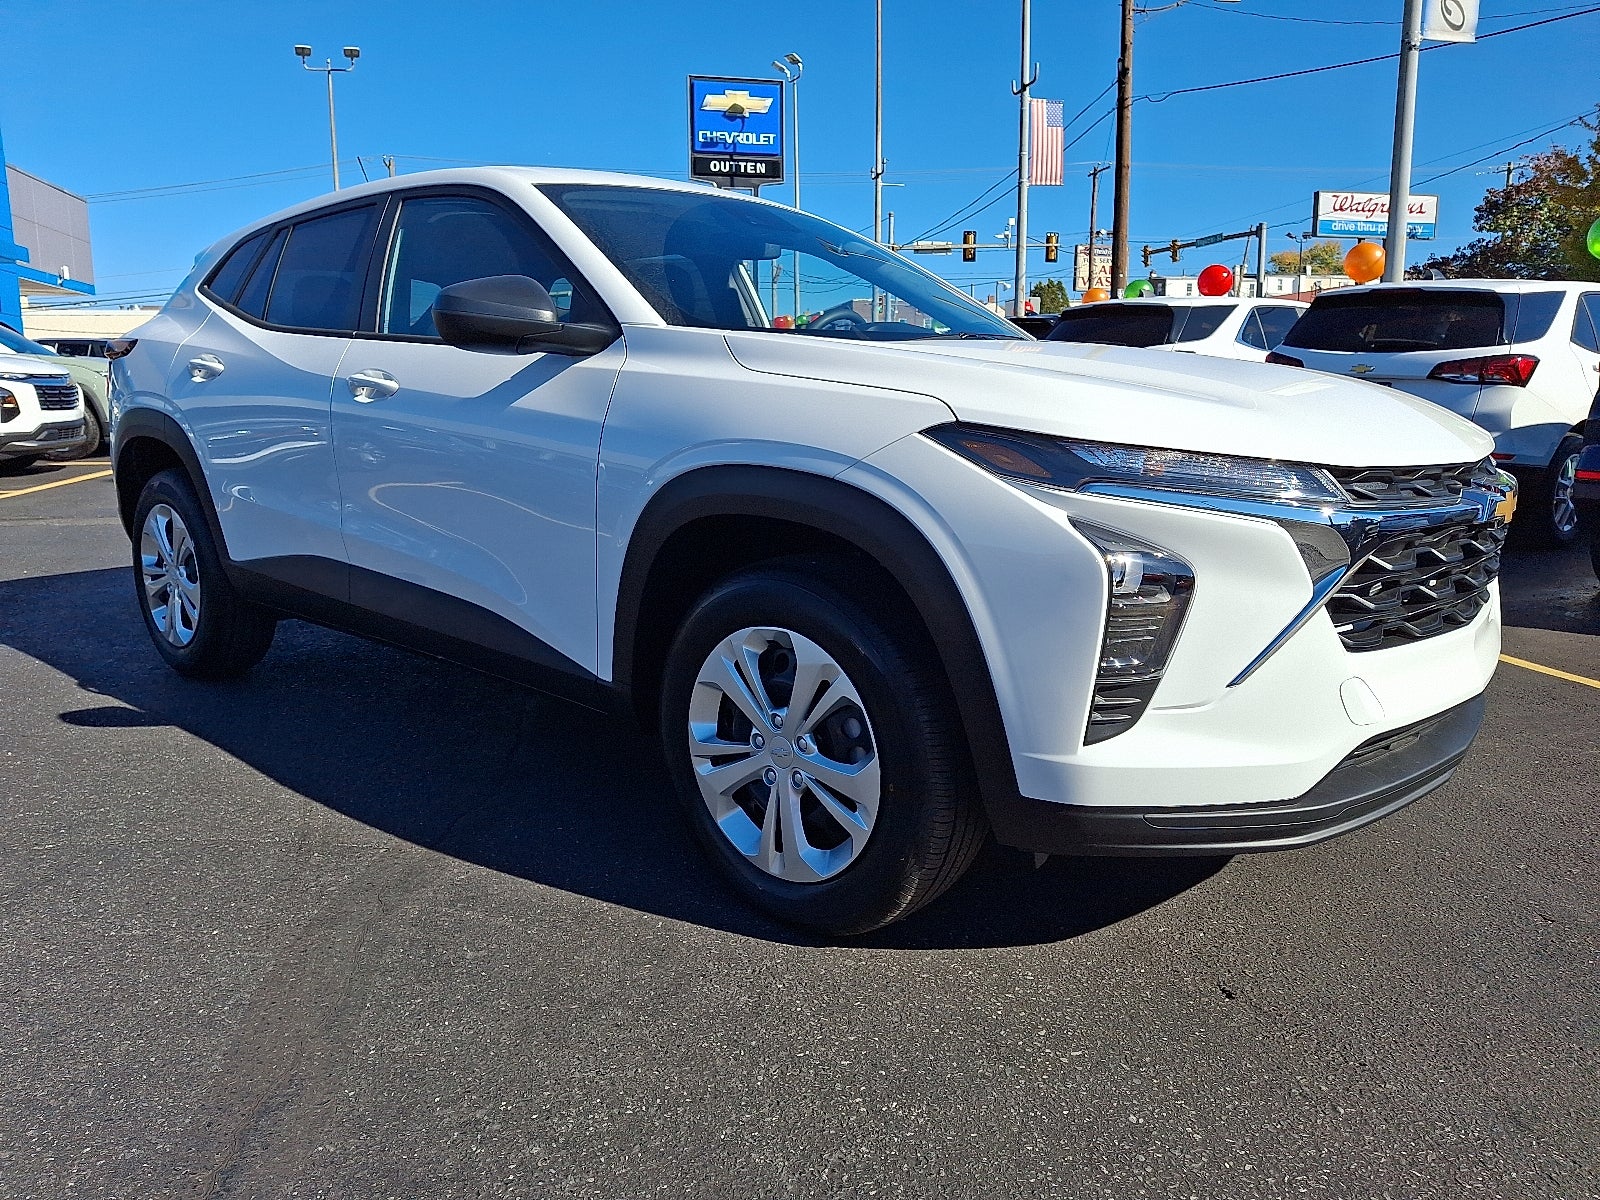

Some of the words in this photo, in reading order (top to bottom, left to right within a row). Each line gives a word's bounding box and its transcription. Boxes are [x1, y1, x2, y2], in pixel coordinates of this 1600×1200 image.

[698, 130, 777, 145] CHEVROLET
[709, 160, 766, 174] OUTTEN
[1331, 221, 1356, 232] drive
[1357, 222, 1376, 232] thru
